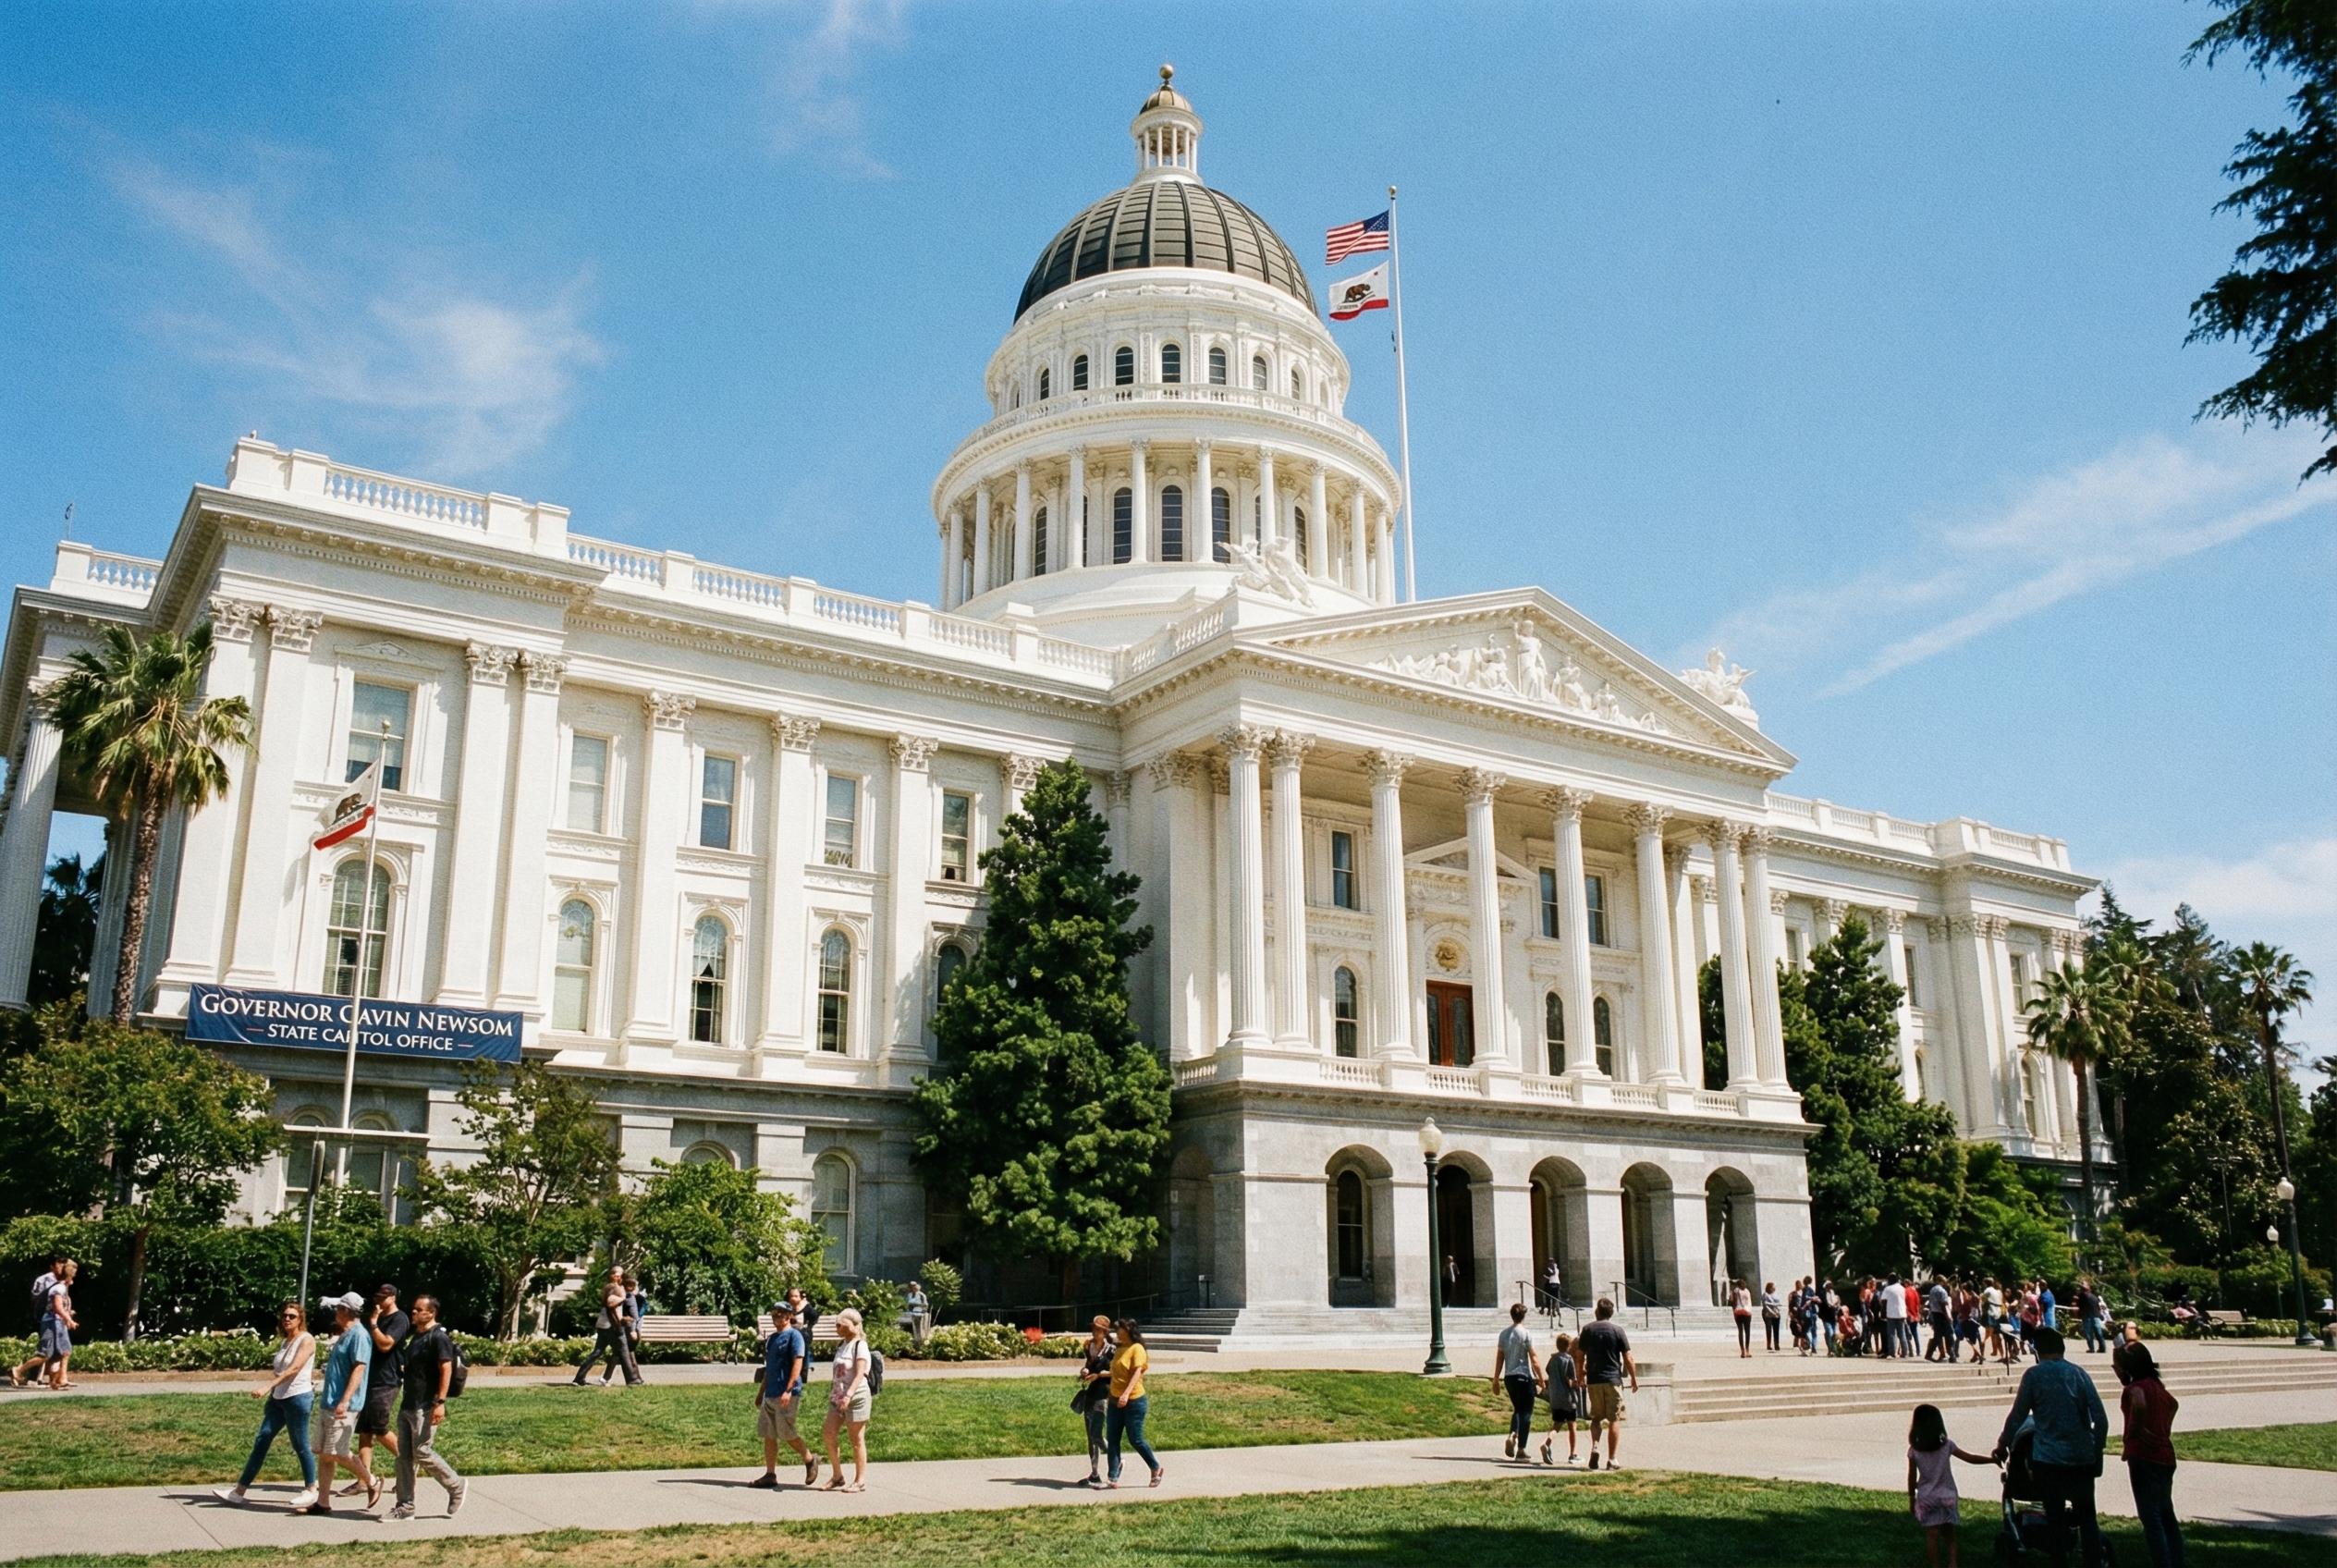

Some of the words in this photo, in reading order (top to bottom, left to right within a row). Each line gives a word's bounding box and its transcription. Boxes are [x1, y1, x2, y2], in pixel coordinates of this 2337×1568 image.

[201, 993, 334, 1022] GOVERNOR
[417, 1011, 513, 1036] NEWSOM
[267, 1023, 318, 1040] STATE
[322, 1028, 393, 1047] CATOL
[397, 1034, 453, 1050] OFFICE
